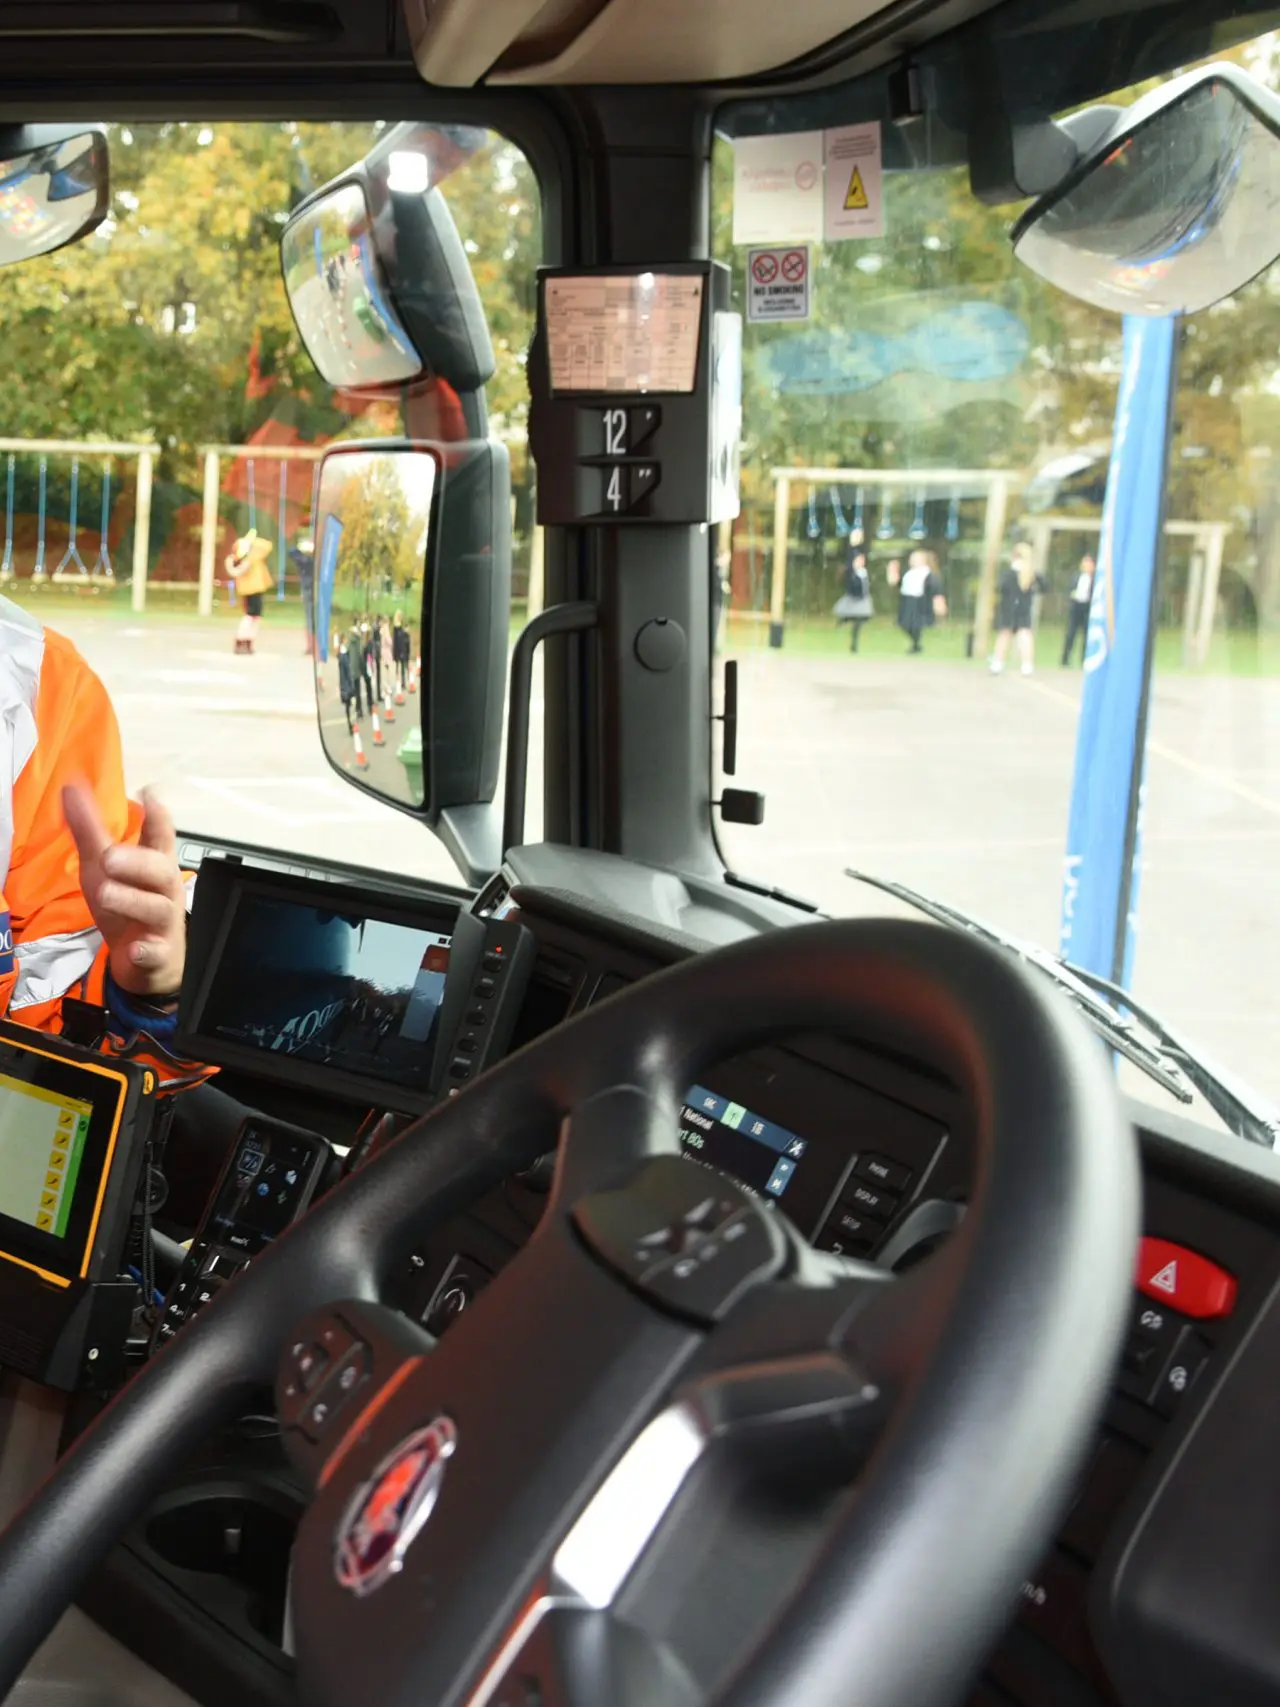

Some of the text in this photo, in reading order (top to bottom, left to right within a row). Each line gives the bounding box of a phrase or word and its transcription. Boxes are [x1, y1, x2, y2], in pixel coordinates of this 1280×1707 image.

[754, 284, 804, 296] NO SMOKING
[684, 1108, 714, 1131] National
